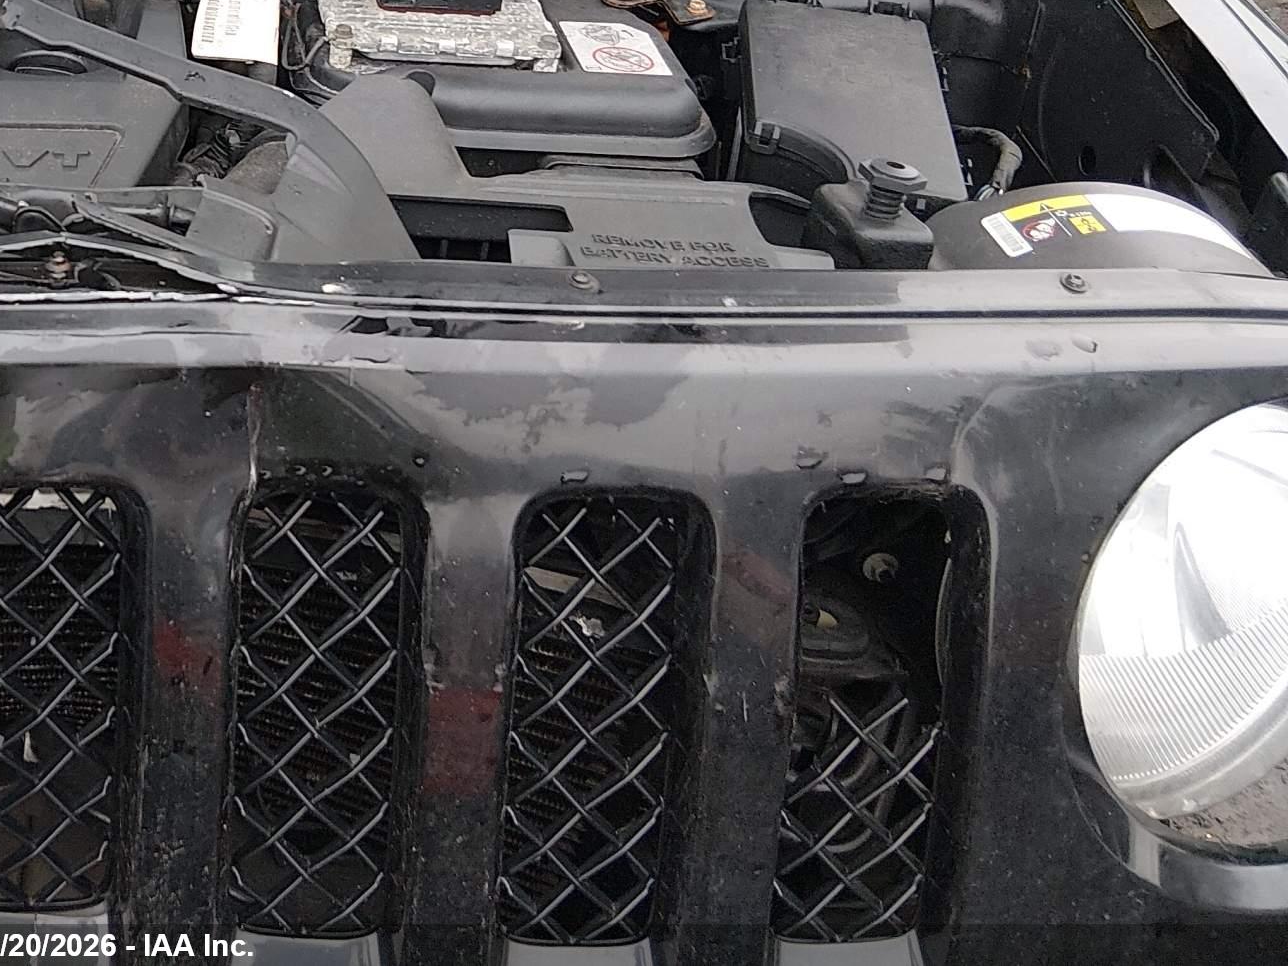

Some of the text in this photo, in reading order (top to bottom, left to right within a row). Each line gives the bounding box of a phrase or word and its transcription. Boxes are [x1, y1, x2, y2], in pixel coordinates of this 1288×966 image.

[592, 234, 737, 253] REMOVE FOR
[580, 246, 770, 268] BATTERY ACCESS
